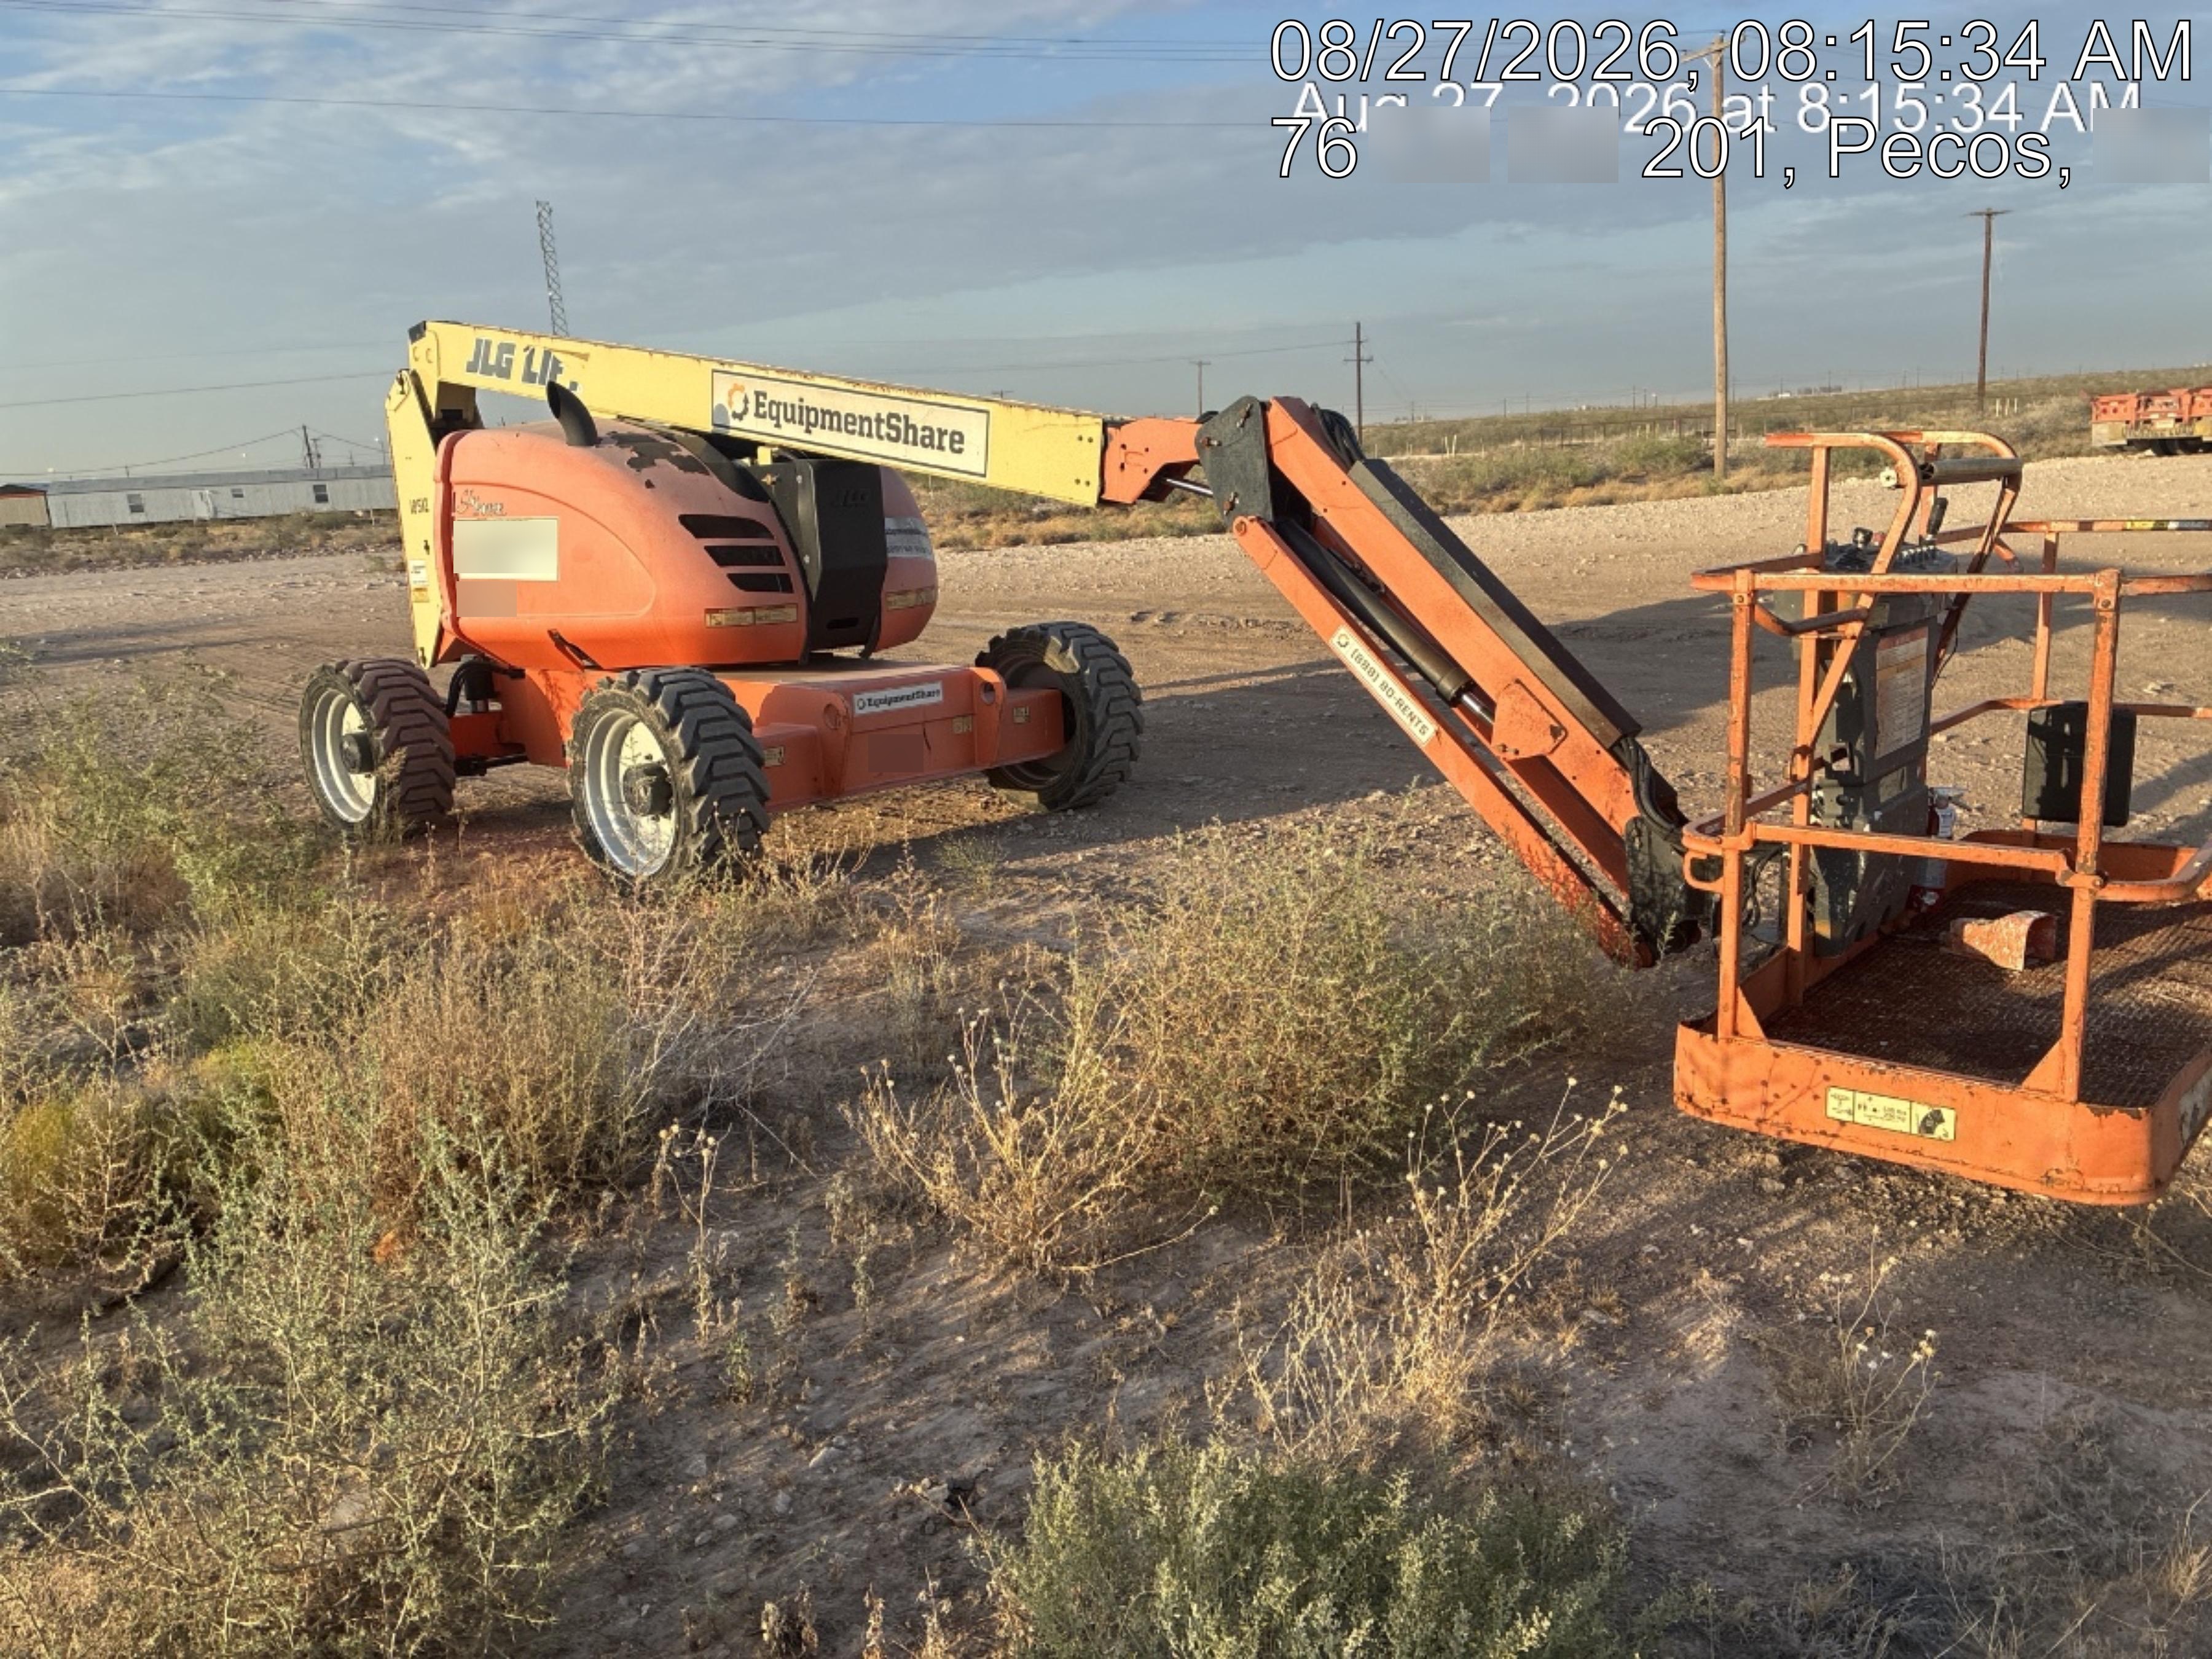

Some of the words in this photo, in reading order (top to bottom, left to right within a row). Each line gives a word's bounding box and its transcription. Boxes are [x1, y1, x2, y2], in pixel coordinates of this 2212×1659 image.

[466, 337, 517, 380] JLG
[753, 390, 965, 454] EquipmentShare
[866, 689, 941, 708] EquipmentShare
